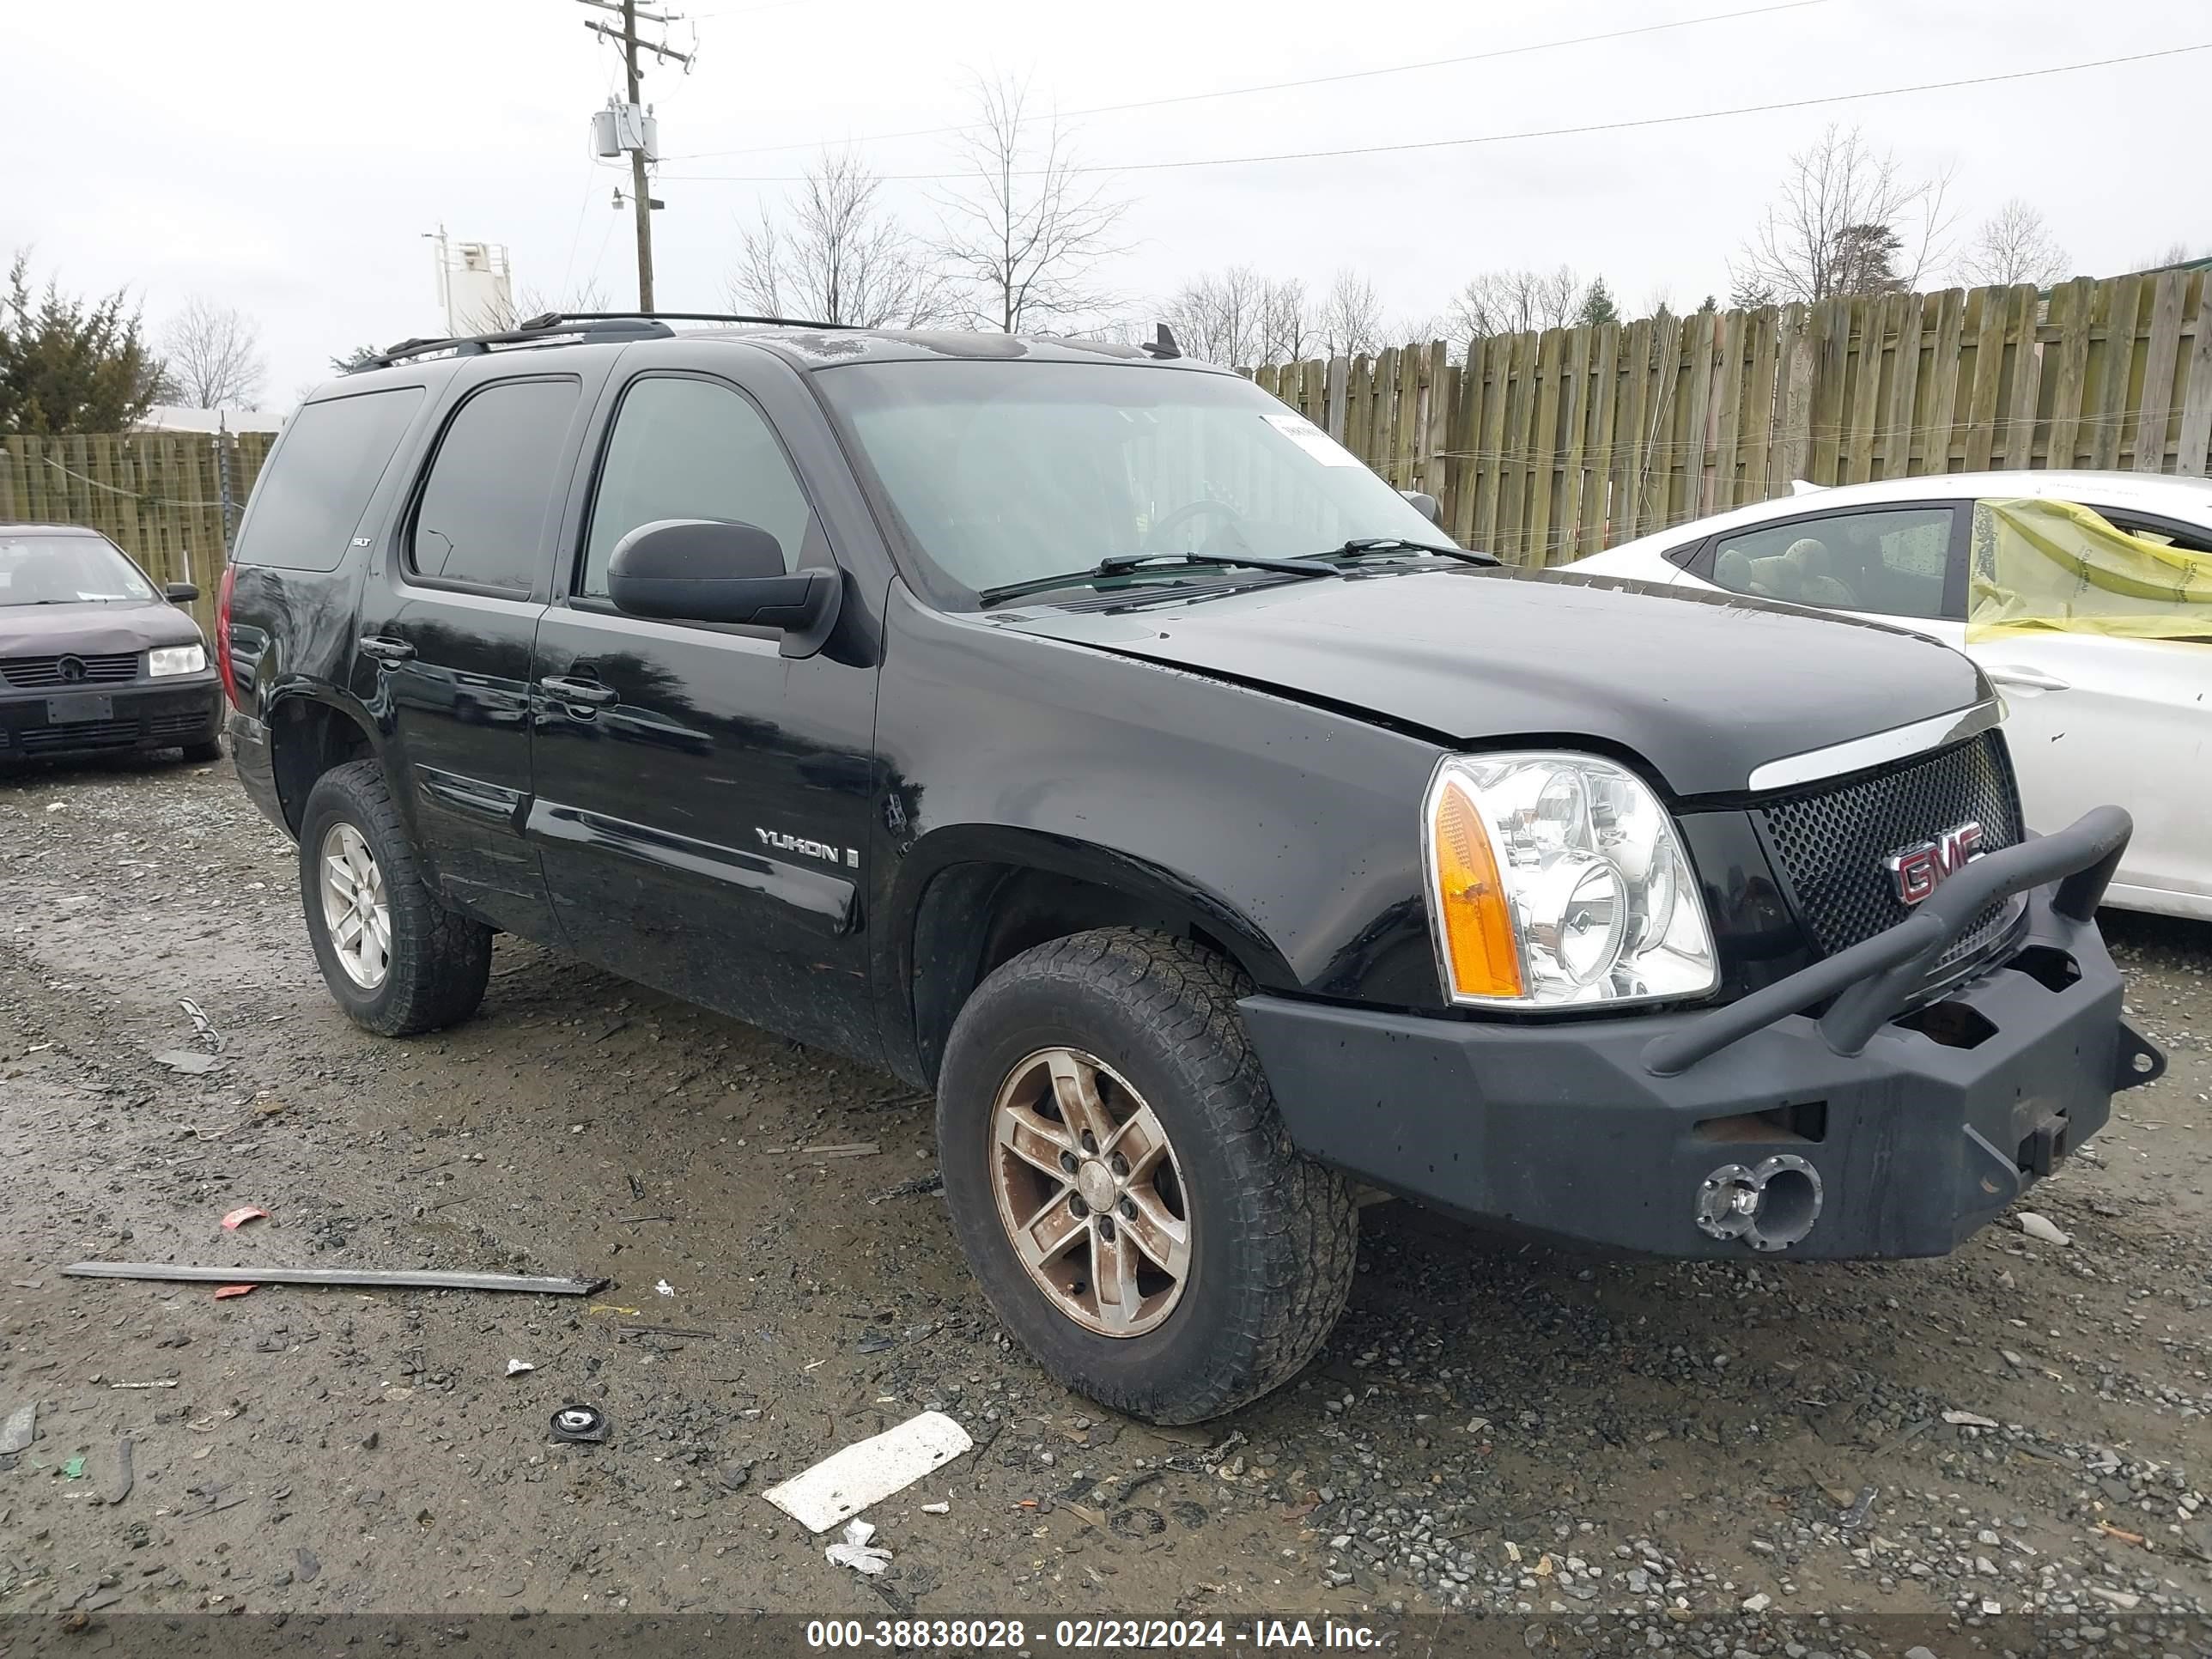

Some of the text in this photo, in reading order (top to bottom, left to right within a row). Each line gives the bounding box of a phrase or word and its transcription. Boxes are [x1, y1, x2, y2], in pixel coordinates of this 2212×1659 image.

[352, 537, 373, 548] SLT
[755, 827, 839, 863] YUKON
[1891, 821, 1986, 906] GMC
